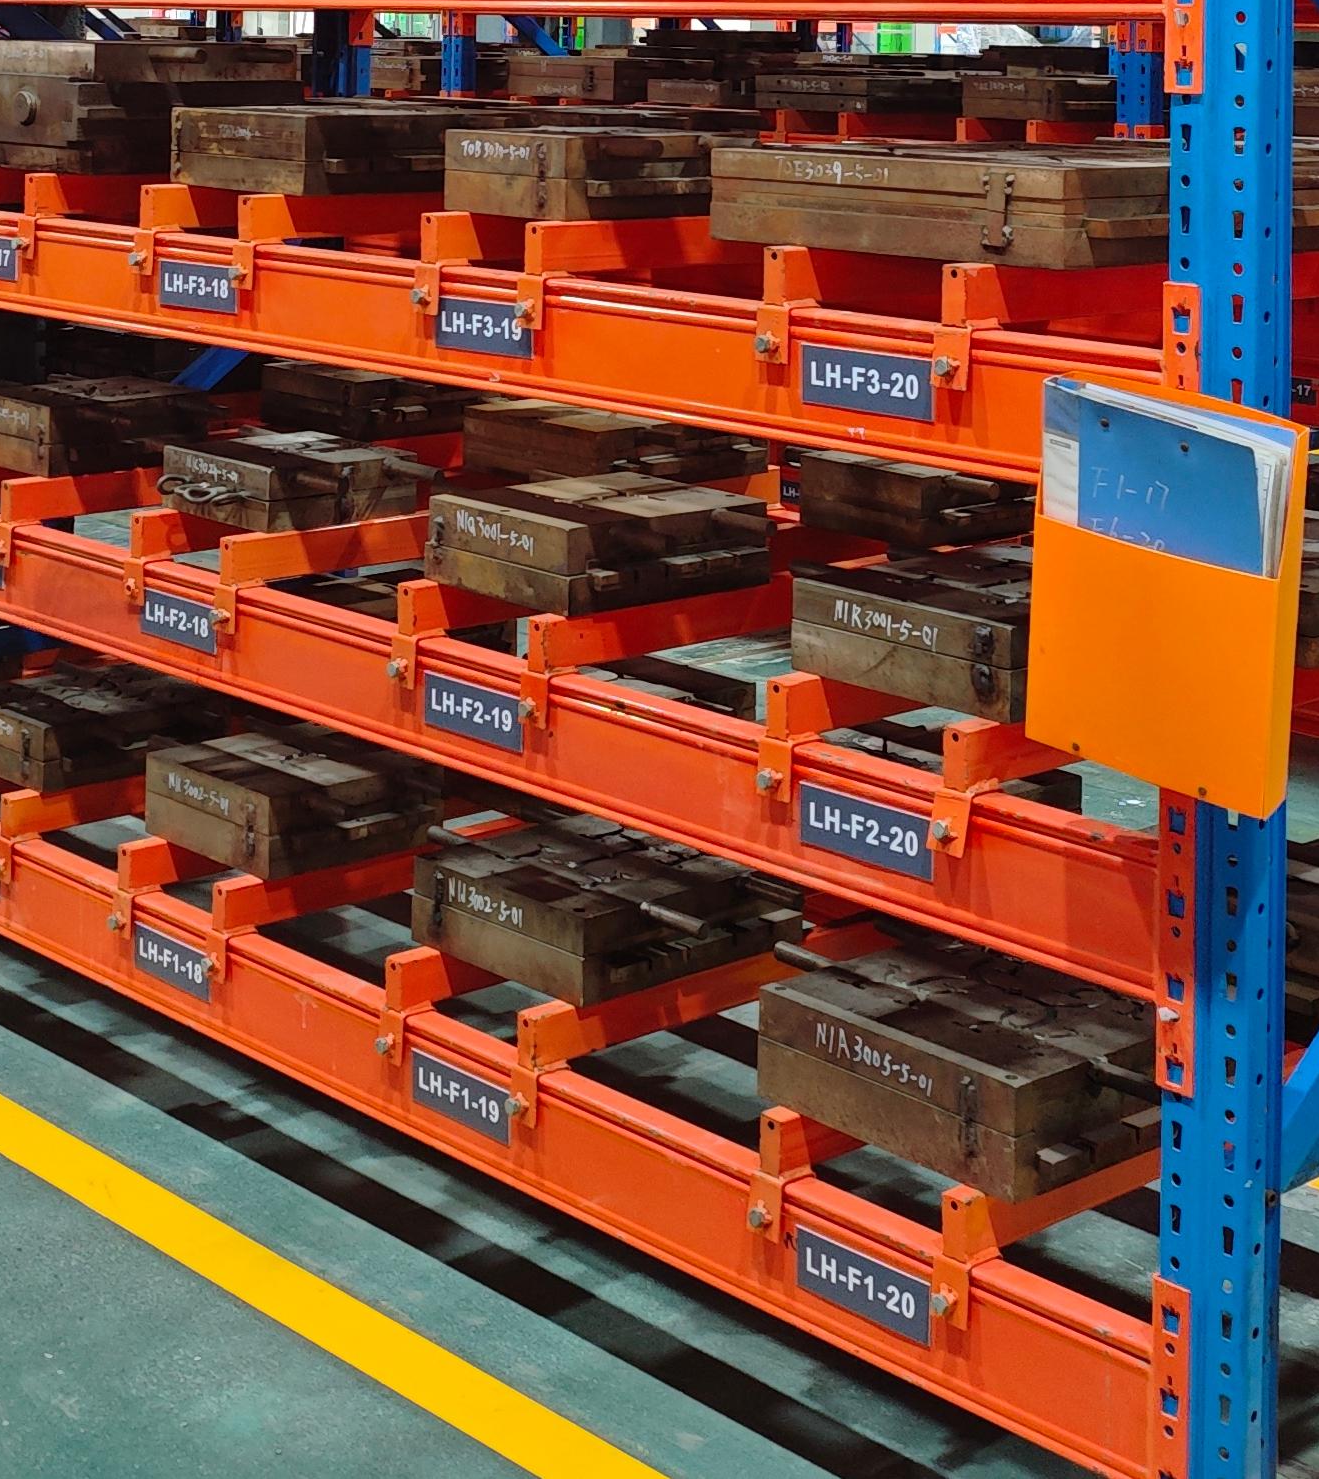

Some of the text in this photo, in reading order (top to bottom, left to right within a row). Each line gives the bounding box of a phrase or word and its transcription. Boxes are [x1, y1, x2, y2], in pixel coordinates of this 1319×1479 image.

[164, 274, 228, 299] LH-F3-18
[441, 311, 522, 341] LH-F3-19
[810, 361, 919, 400] LH-F3-20
[145, 601, 209, 638] LH-F2-18
[431, 688, 512, 732] LH-F2-19
[809, 804, 919, 857] LH-F2-20
[139, 937, 203, 984] LH-F1-18
[816, 1023, 933, 1096] NIA3005-5-01
[418, 1067, 499, 1124] LH-F1-19
[806, 1246, 915, 1318] LH-F1-20
